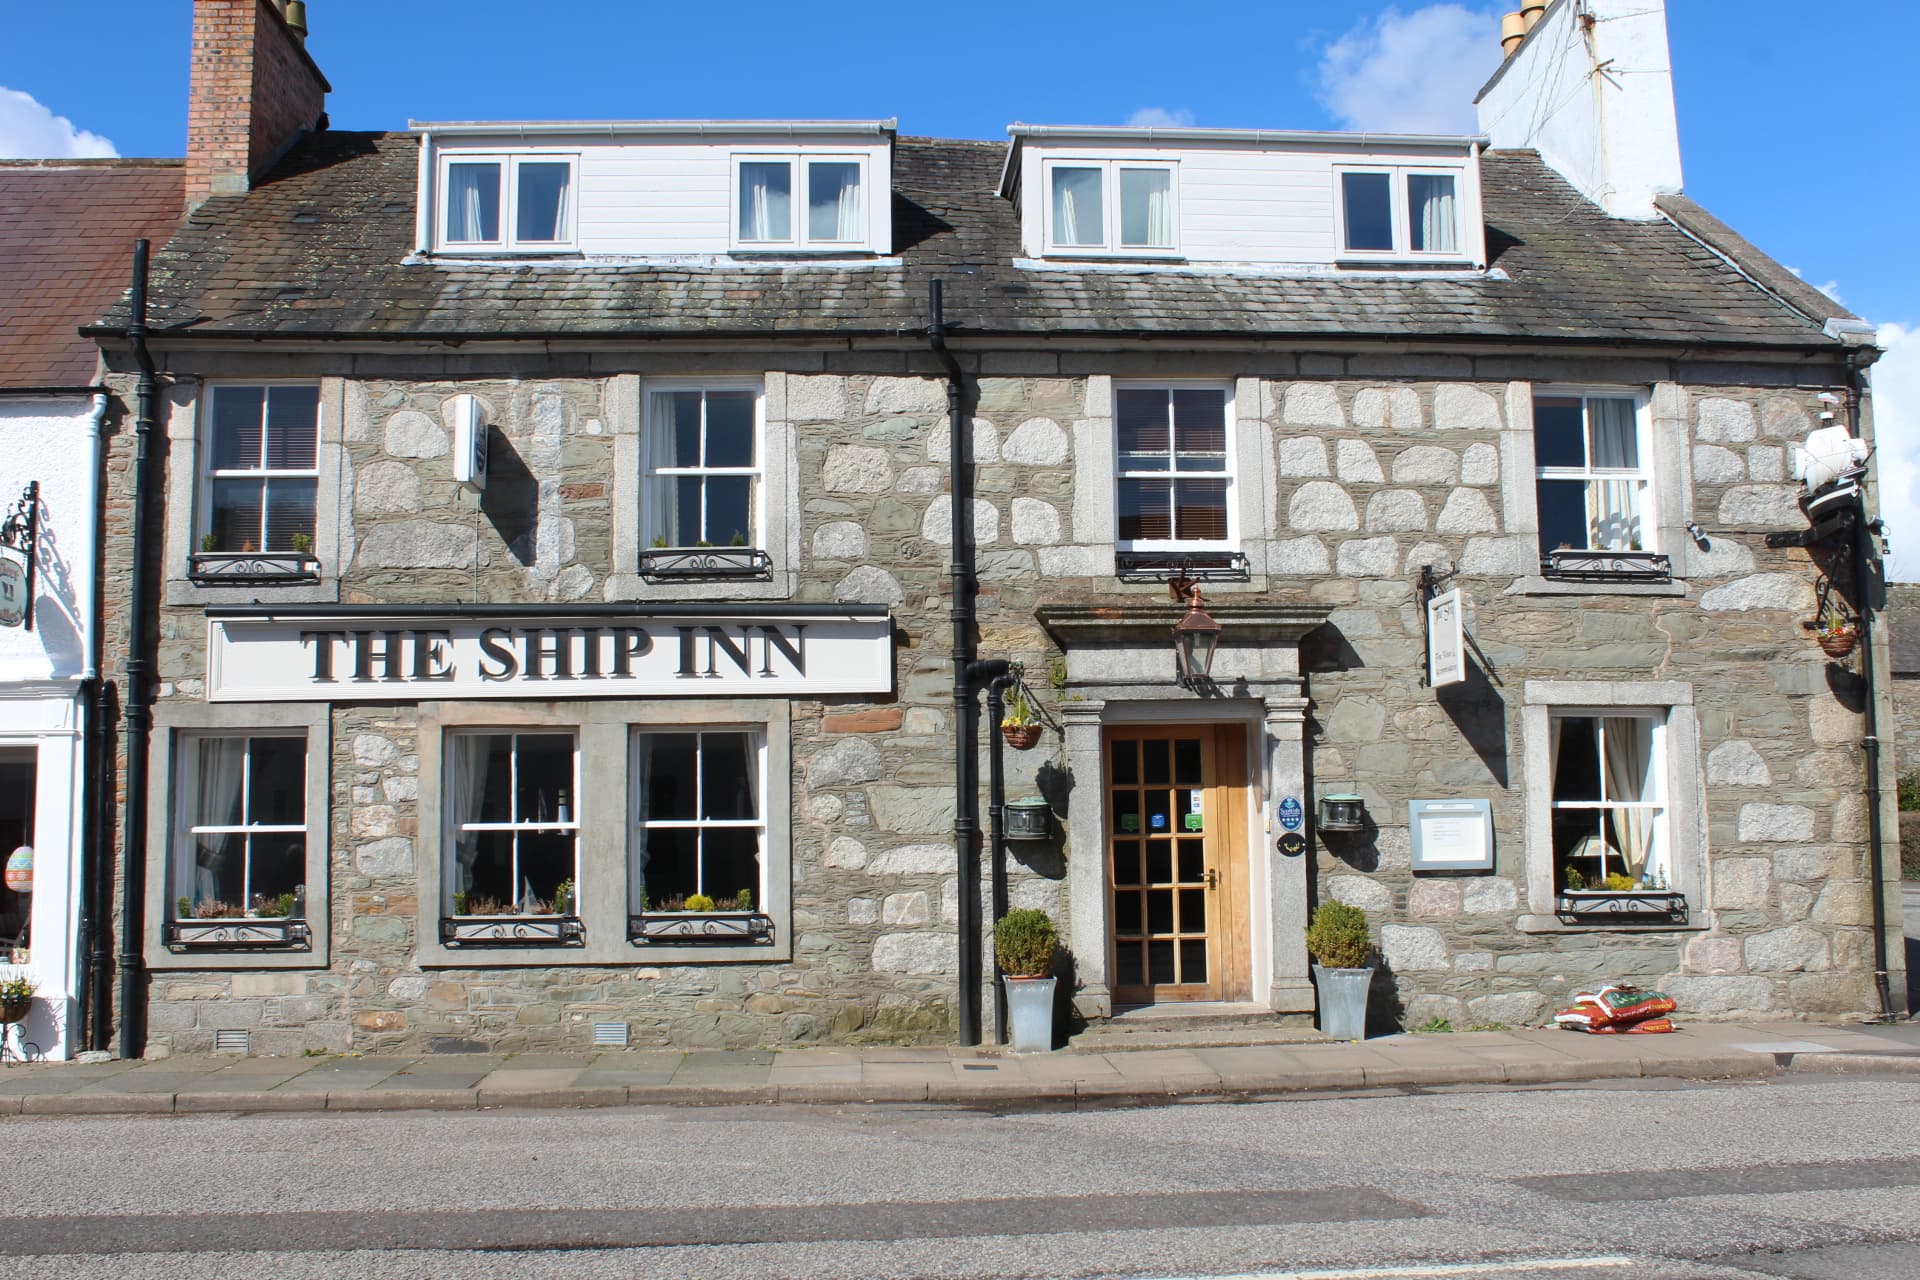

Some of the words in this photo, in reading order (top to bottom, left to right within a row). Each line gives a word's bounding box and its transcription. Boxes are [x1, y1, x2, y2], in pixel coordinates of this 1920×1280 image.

[300, 628, 455, 682] THE
[479, 626, 652, 681] SHIP
[672, 624, 808, 678] INN
